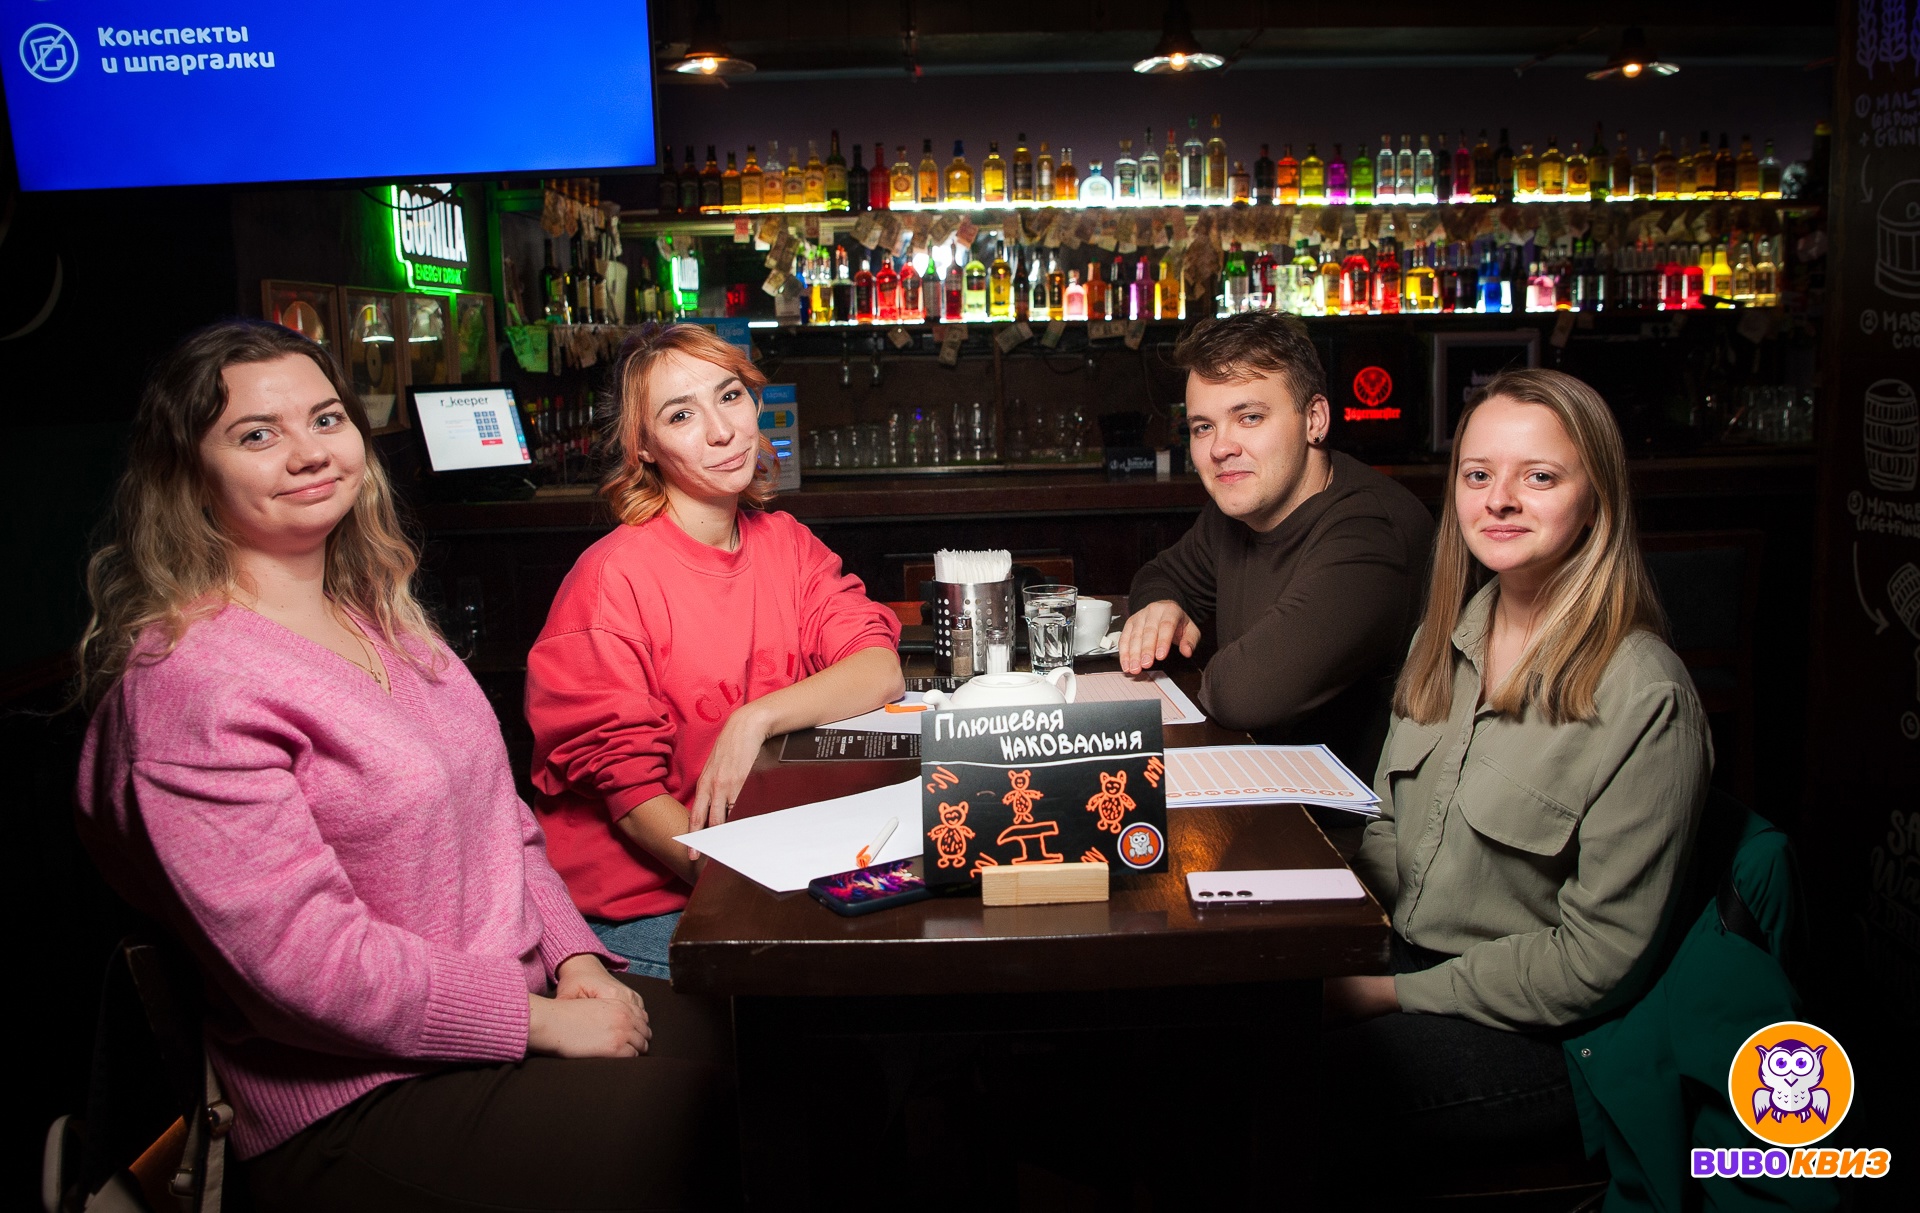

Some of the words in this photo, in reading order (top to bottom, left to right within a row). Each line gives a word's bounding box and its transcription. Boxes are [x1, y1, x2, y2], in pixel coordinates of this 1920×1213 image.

[97, 25, 249, 47] Конспекты
[101, 56, 118, 73] и
[123, 51, 275, 76] шпаргалки
[399, 188, 468, 263] GORILLA
